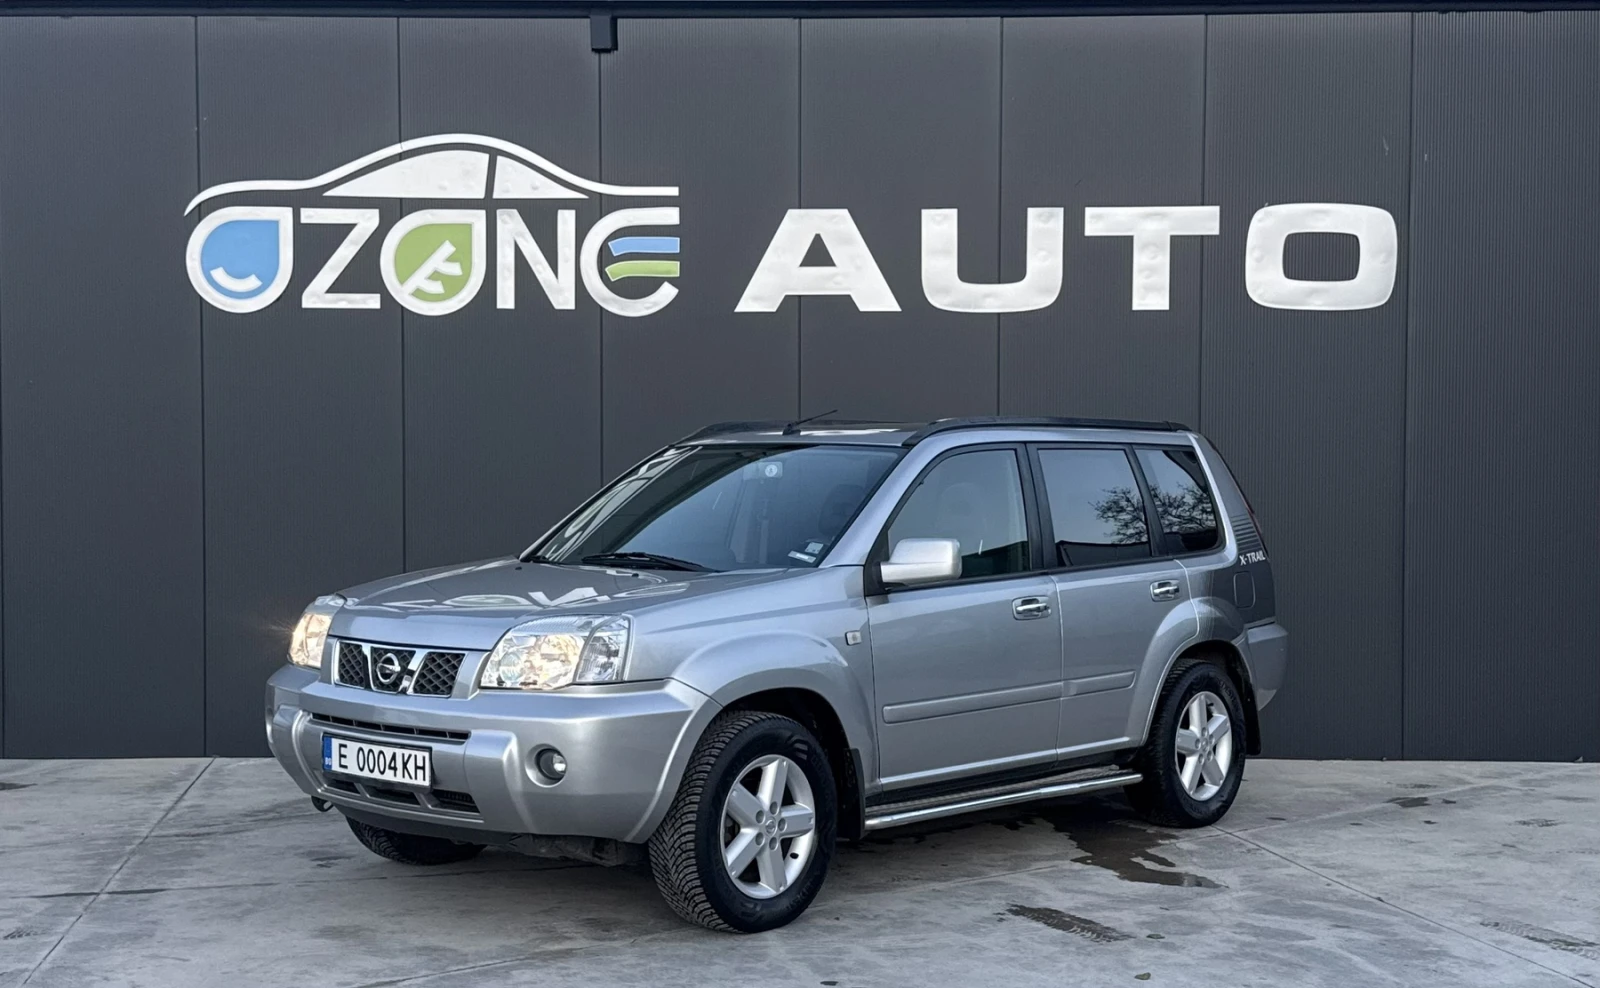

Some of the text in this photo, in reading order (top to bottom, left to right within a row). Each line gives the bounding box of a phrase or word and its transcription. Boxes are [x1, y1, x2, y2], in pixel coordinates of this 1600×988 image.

[186, 203, 1398, 317] OZONE AUTO
[1239, 550, 1266, 566] X-TRAIL
[338, 742, 348, 769] E
